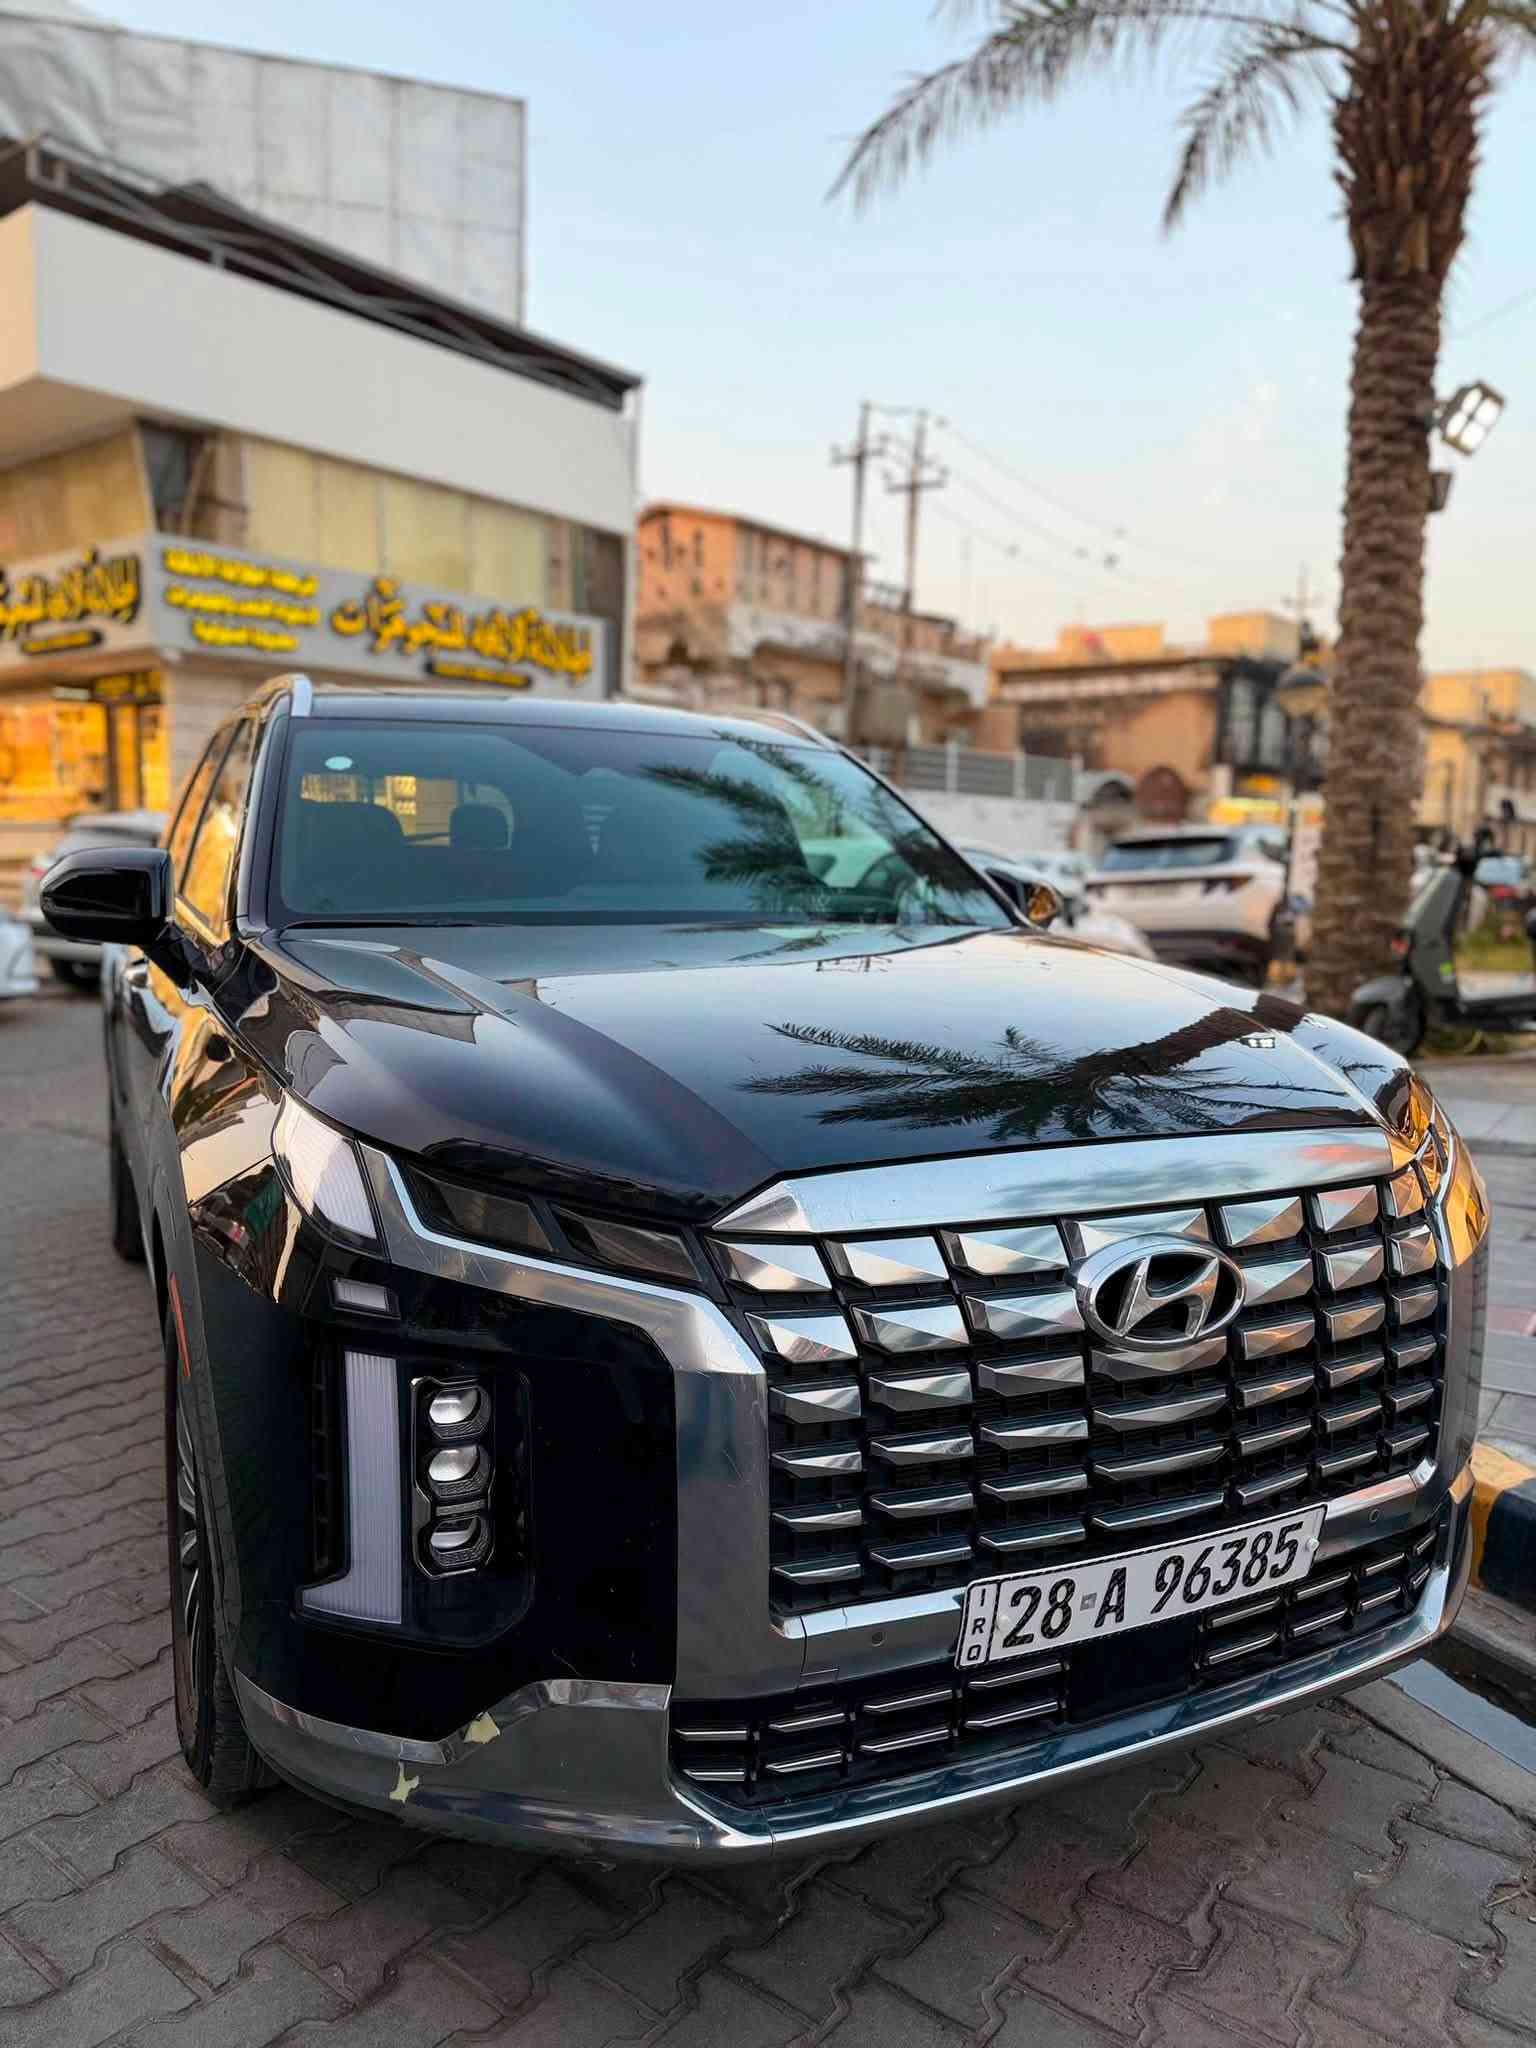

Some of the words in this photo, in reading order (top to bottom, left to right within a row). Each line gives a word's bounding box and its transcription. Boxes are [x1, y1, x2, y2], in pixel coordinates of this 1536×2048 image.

[1002, 1577, 1076, 1648] 28
[1094, 1566, 1127, 1628] A
[1150, 1521, 1304, 1615] 96385
